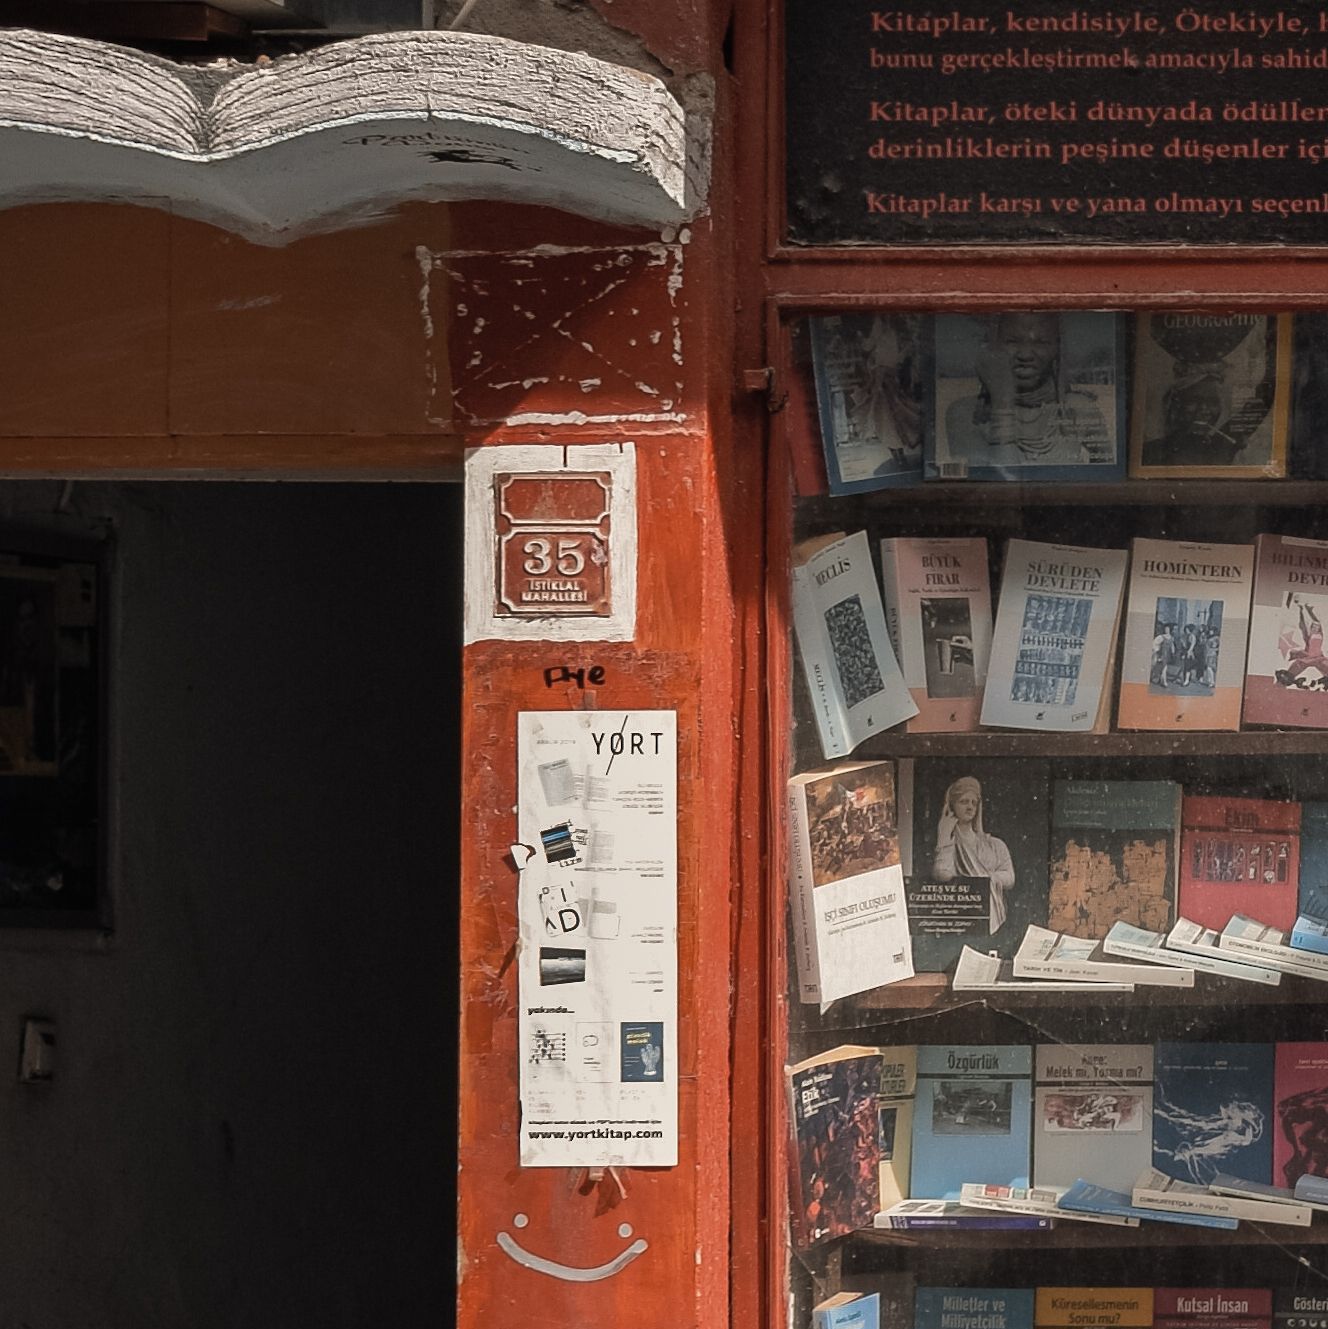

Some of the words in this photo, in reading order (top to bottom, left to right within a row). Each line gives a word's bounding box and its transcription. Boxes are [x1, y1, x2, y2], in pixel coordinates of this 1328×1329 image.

[871, 11, 996, 38] Kitaplar,
[1006, 10, 1168, 35] kendisiyle,
[1174, 9, 1309, 36] Ötekiyle,
[870, 48, 933, 69] bunu
[940, 47, 1140, 73] gerçekleştirmek
[1144, 48, 1255, 71] amacıyla
[870, 100, 993, 128] Kitaplar,
[1003, 100, 1078, 122] öteki
[1087, 99, 1214, 128] dünyada
[867, 136, 1053, 160] derinliklerin
[1060, 140, 1154, 165] peşine
[1162, 136, 1290, 163] düşenler
[867, 192, 971, 220] Kitaplar
[979, 192, 1042, 216] karşı
[1050, 197, 1080, 213] ve
[1088, 197, 1148, 216] yana
[1153, 192, 1244, 216] olmayı
[523, 538, 585, 575] 35
[922, 554, 962, 569] BÜYÜK
[1027, 560, 1103, 581] SÜRÜDEN
[1143, 558, 1243, 578] HOMİNTERN
[925, 572, 961, 586] FIRAR
[1027, 576, 1101, 592] DEVLETE
[920, 884, 943, 895] ATEŞ
[944, 884, 956, 894] VE
[957, 884, 970, 894] SU
[950, 893, 982, 903] DANS
[947, 1050, 999, 1073] Özgürlük
[528, 1128, 663, 1141] www.yortkitap.com
[943, 1296, 987, 1312] Milletler
[989, 1300, 1006, 1311] ve
[1176, 1297, 1214, 1314] Kutsal
[1216, 1296, 1249, 1314] İnsan
[1068, 1312, 1091, 1324] Sonu
[1097, 1312, 1121, 1324] mu?
